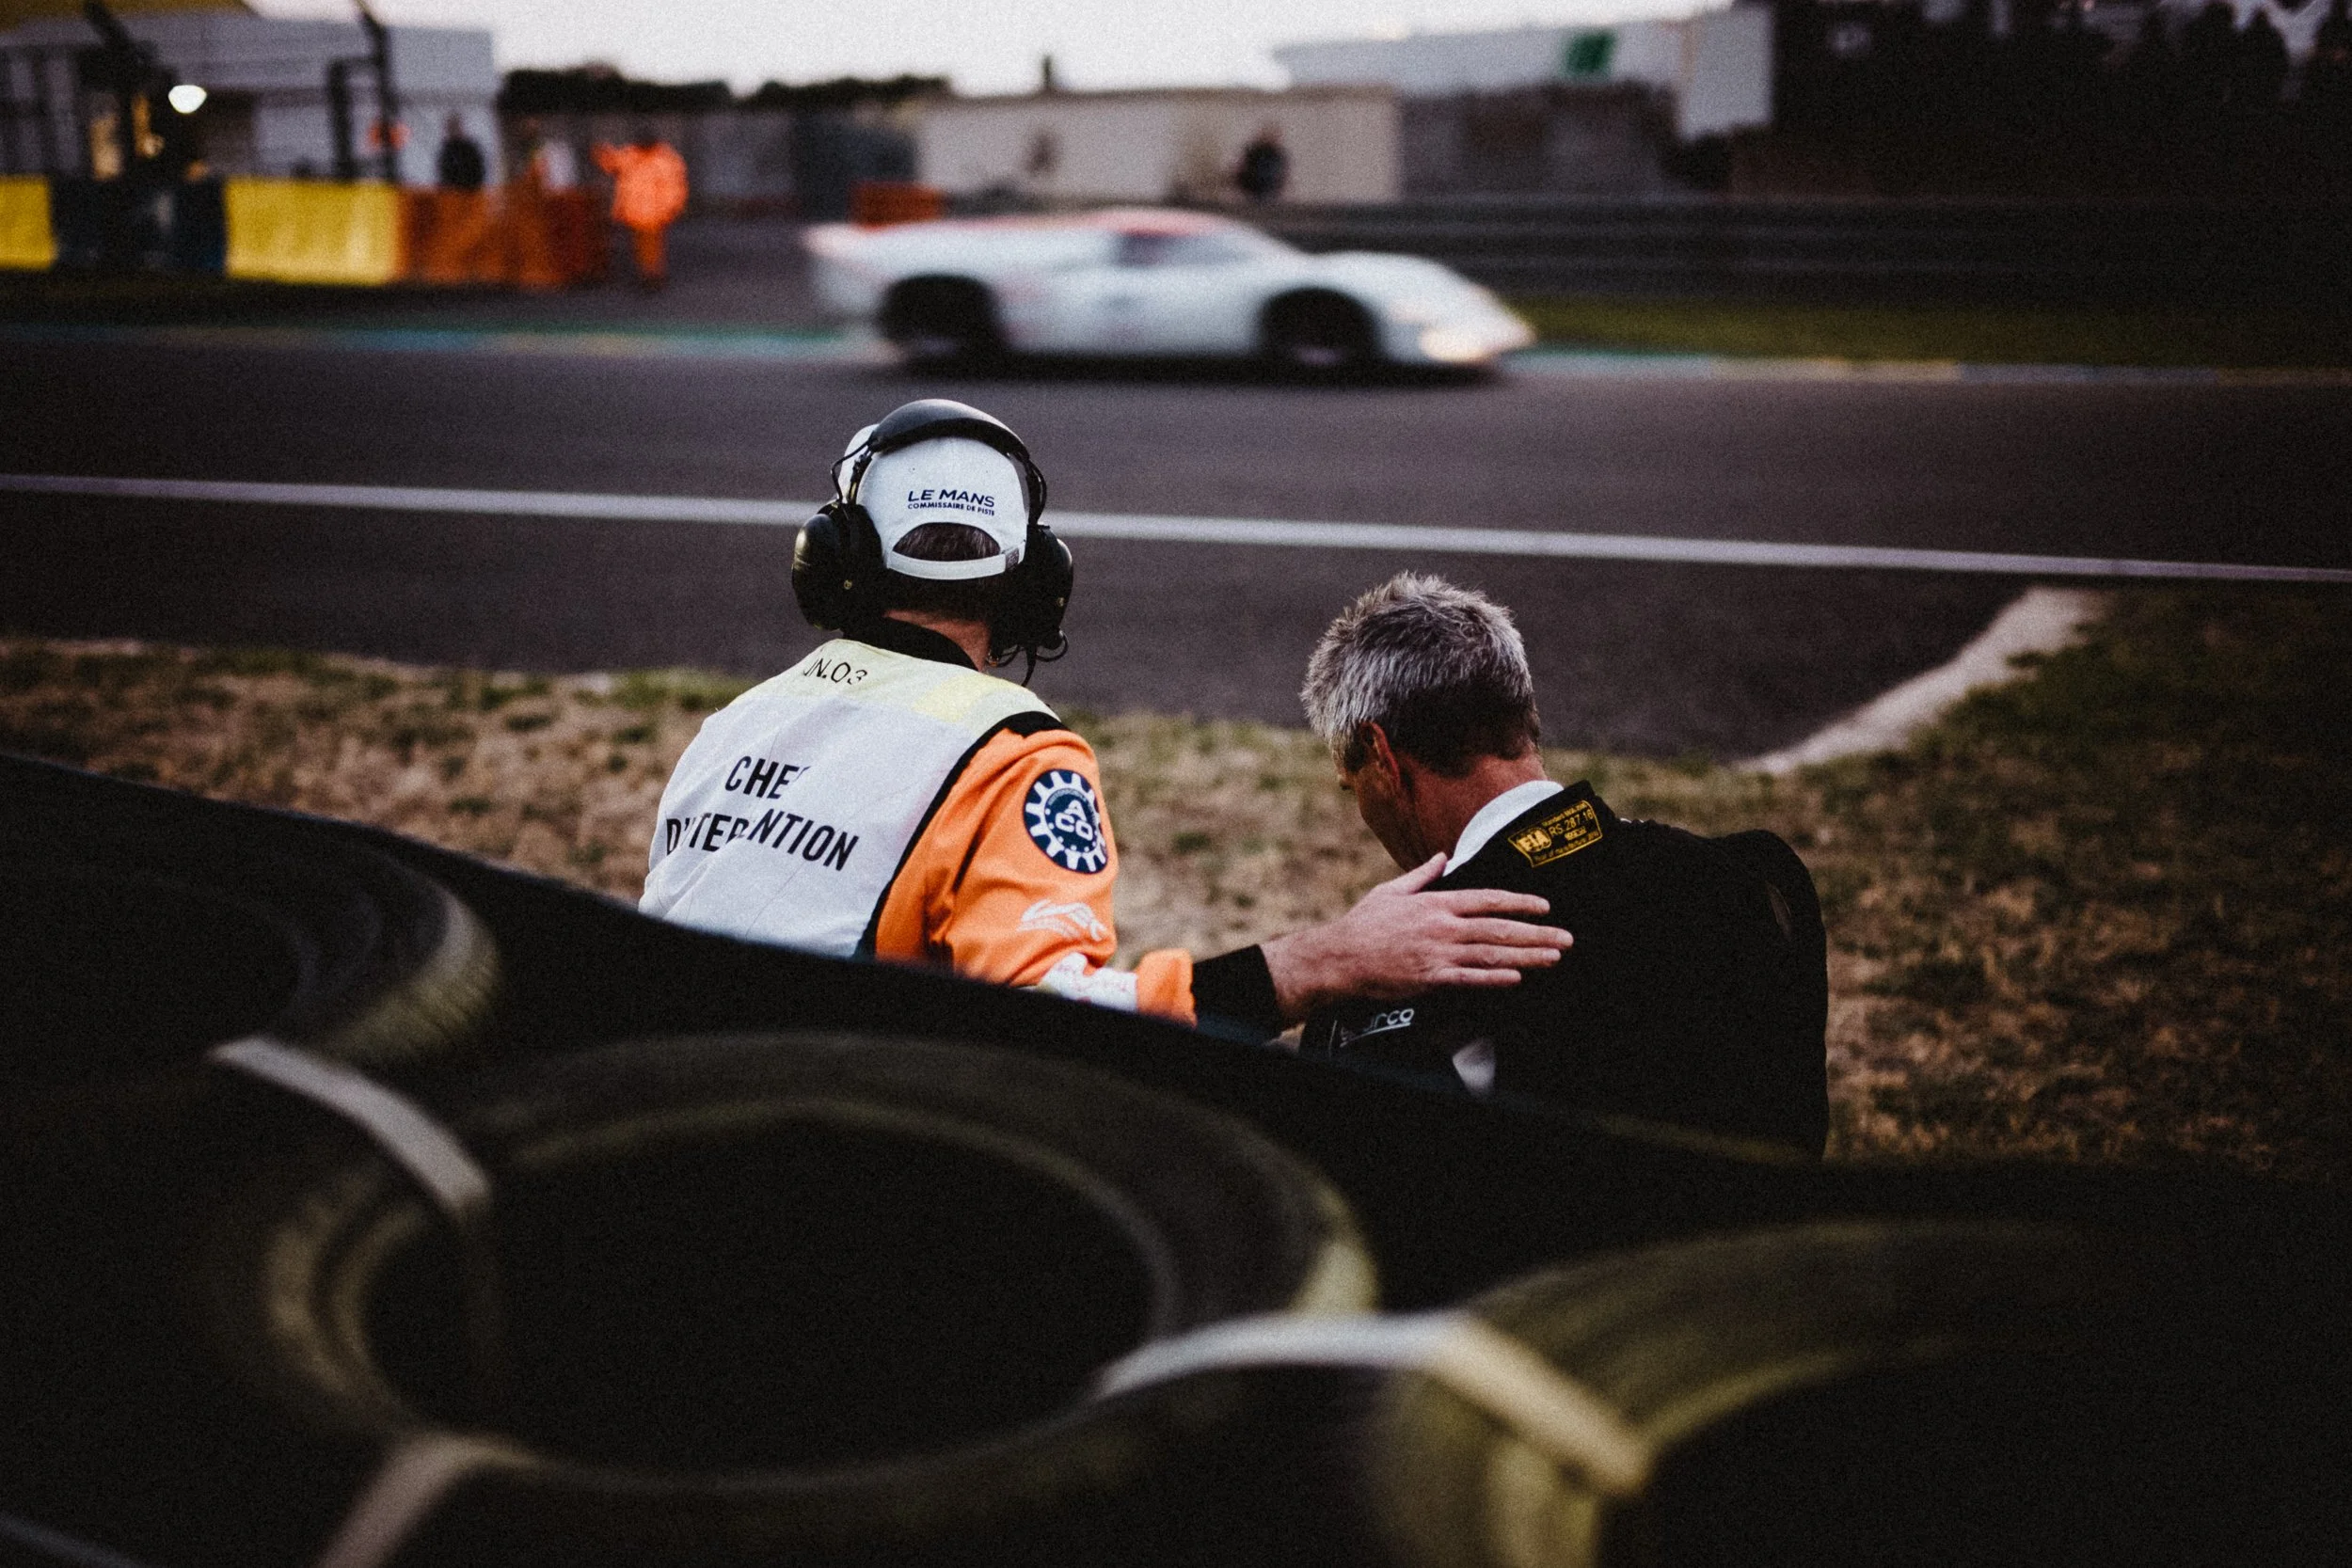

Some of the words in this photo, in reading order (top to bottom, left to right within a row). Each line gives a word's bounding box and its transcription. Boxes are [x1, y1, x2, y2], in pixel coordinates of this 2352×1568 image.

[908, 489, 934, 501] LE
[939, 489, 994, 508] MANS
[908, 501, 964, 510] COMMISSAIRE
[725, 755, 811, 800] CHE
